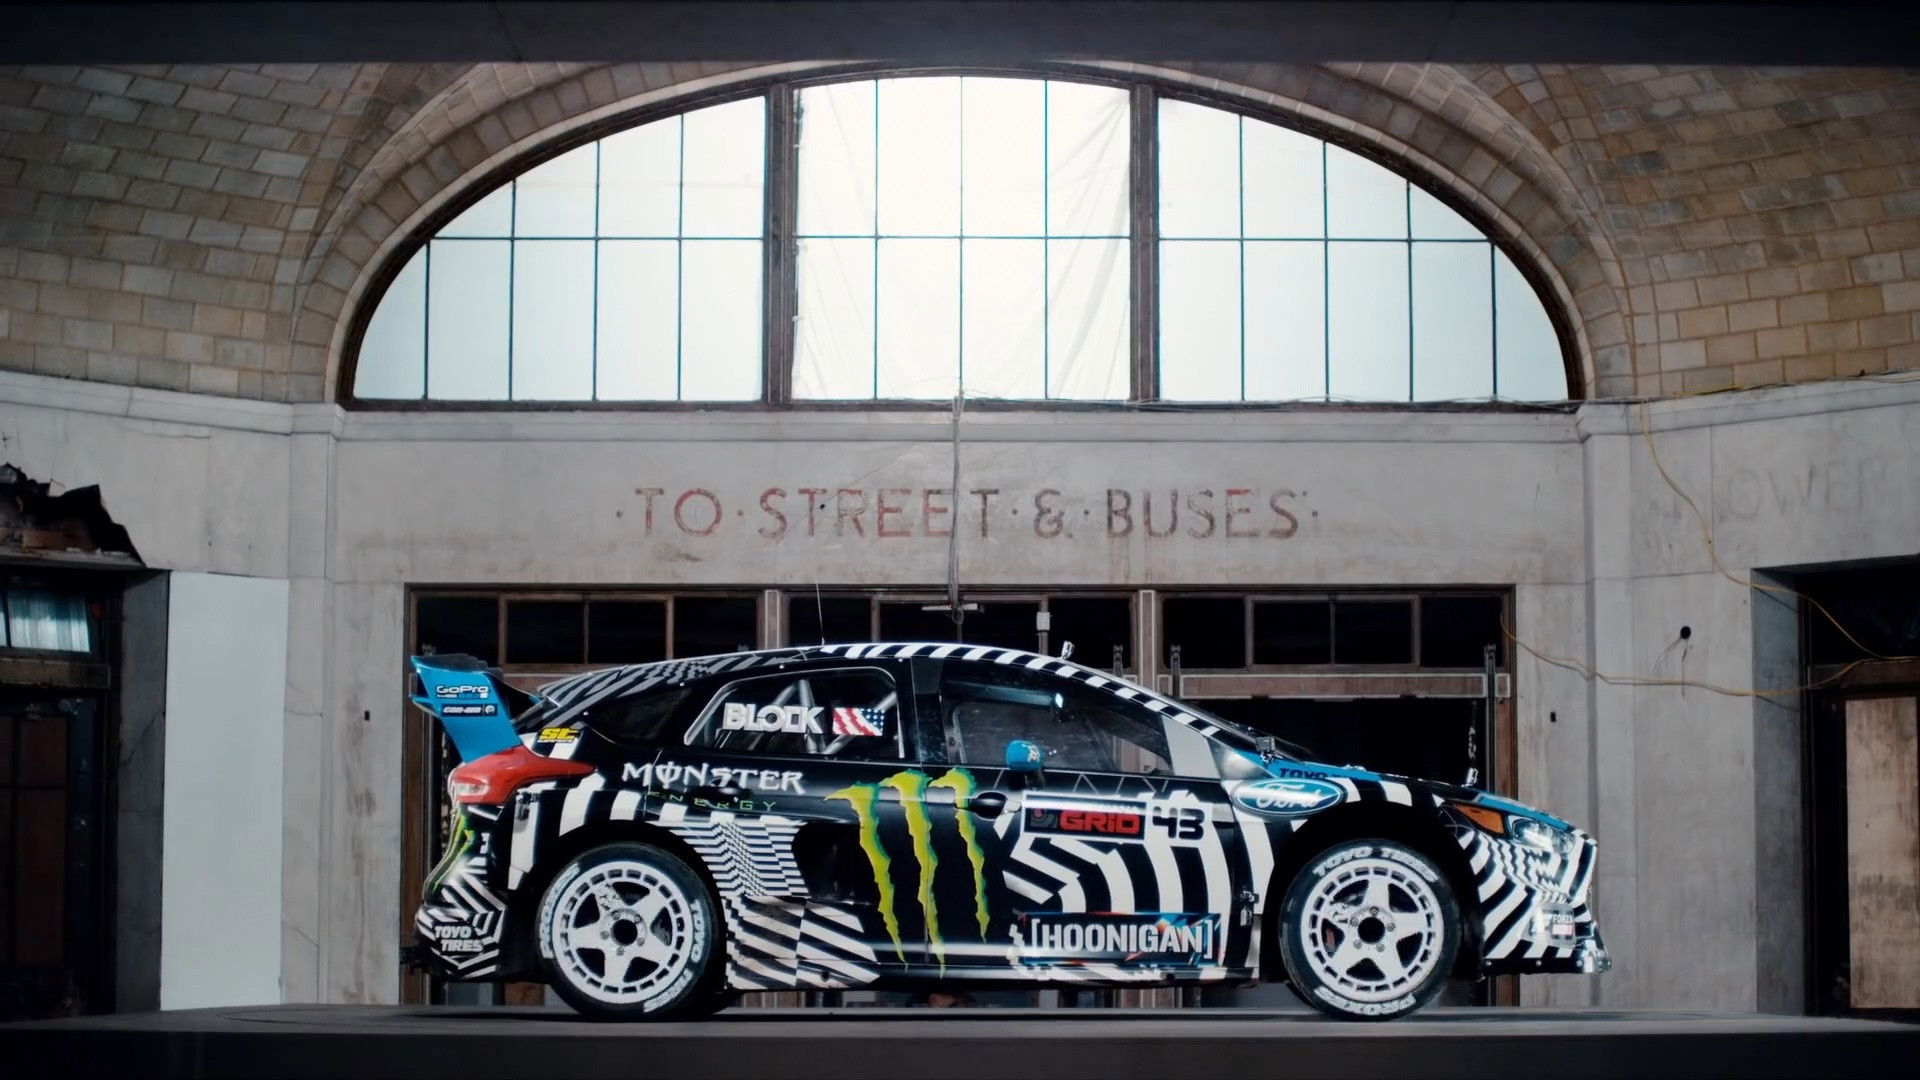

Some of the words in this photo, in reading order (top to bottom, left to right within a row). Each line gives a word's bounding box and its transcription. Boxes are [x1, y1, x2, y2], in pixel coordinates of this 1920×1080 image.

[635, 487, 723, 538] TO
[757, 487, 1000, 539] STREET
[1106, 488, 1299, 540] BUSES
[436, 685, 489, 694] GoPro
[722, 703, 825, 734] BLOCK
[621, 761, 806, 795] MONSTER
[646, 790, 777, 811] ENERGY
[1255, 783, 1326, 809] Ford
[1152, 806, 1206, 840] 43
[434, 925, 472, 939] TOYO
[440, 939, 484, 952] TIRES
